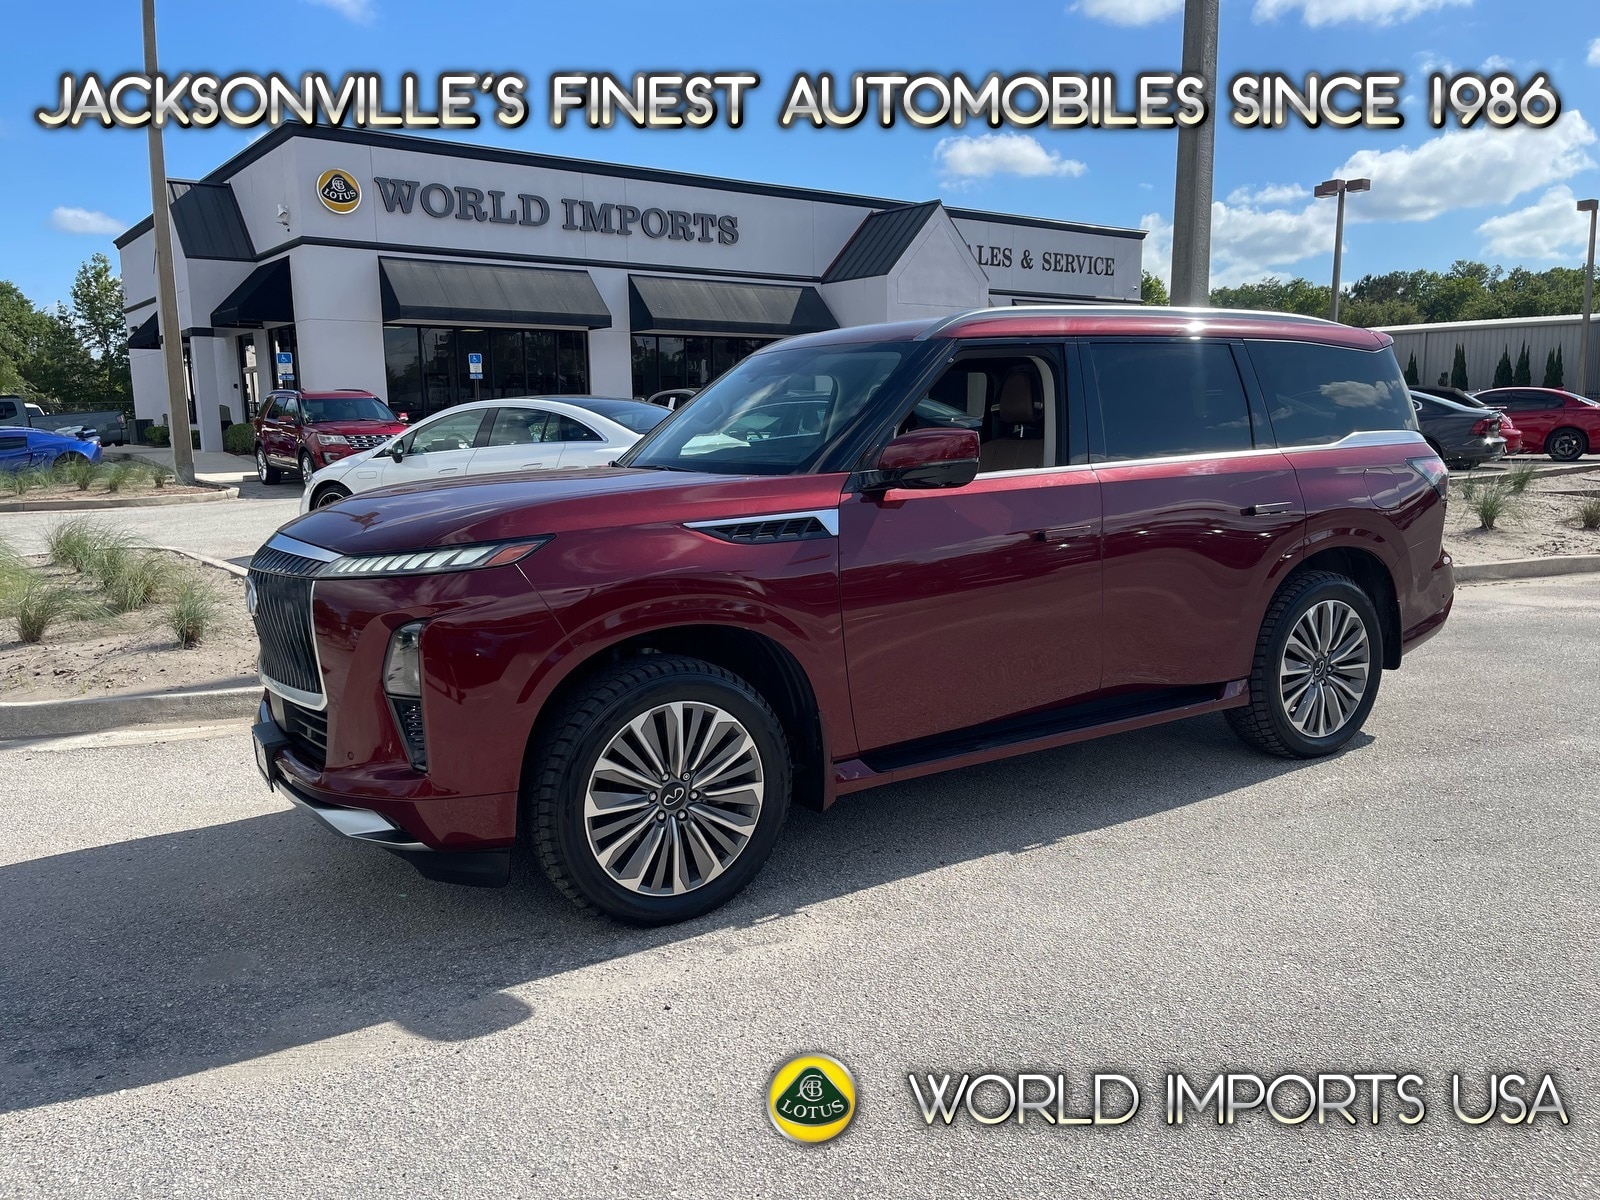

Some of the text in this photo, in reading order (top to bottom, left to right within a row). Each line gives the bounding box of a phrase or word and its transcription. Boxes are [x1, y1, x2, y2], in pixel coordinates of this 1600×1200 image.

[323, 188, 356, 201] LOTUS
[374, 176, 740, 246] WORLD IMPORTS
[967, 244, 1115, 276] LES & SERVICE
